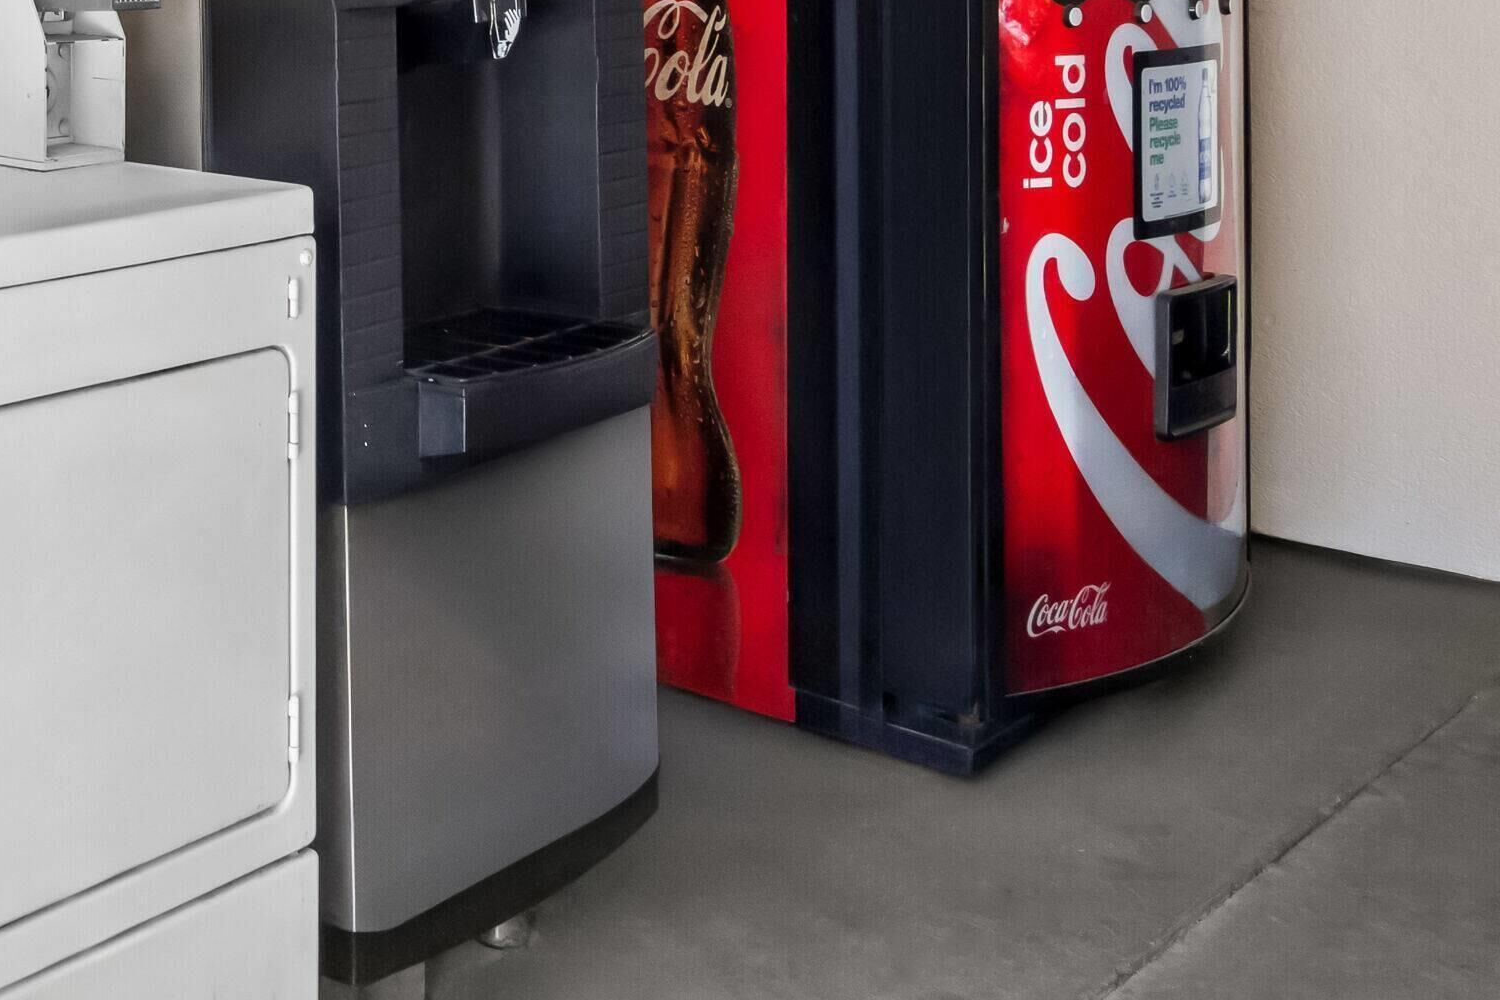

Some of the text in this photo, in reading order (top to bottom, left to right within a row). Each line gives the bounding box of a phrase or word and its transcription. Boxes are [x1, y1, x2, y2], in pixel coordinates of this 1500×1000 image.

[1148, 76, 1187, 95] I'm 100%
[1148, 93, 1186, 114] recycled
[1055, 54, 1087, 188] cold
[1149, 117, 1178, 131] Please
[1023, 100, 1053, 189] ice
[1149, 132, 1181, 149] recycle
[1149, 153, 1165, 166] me
